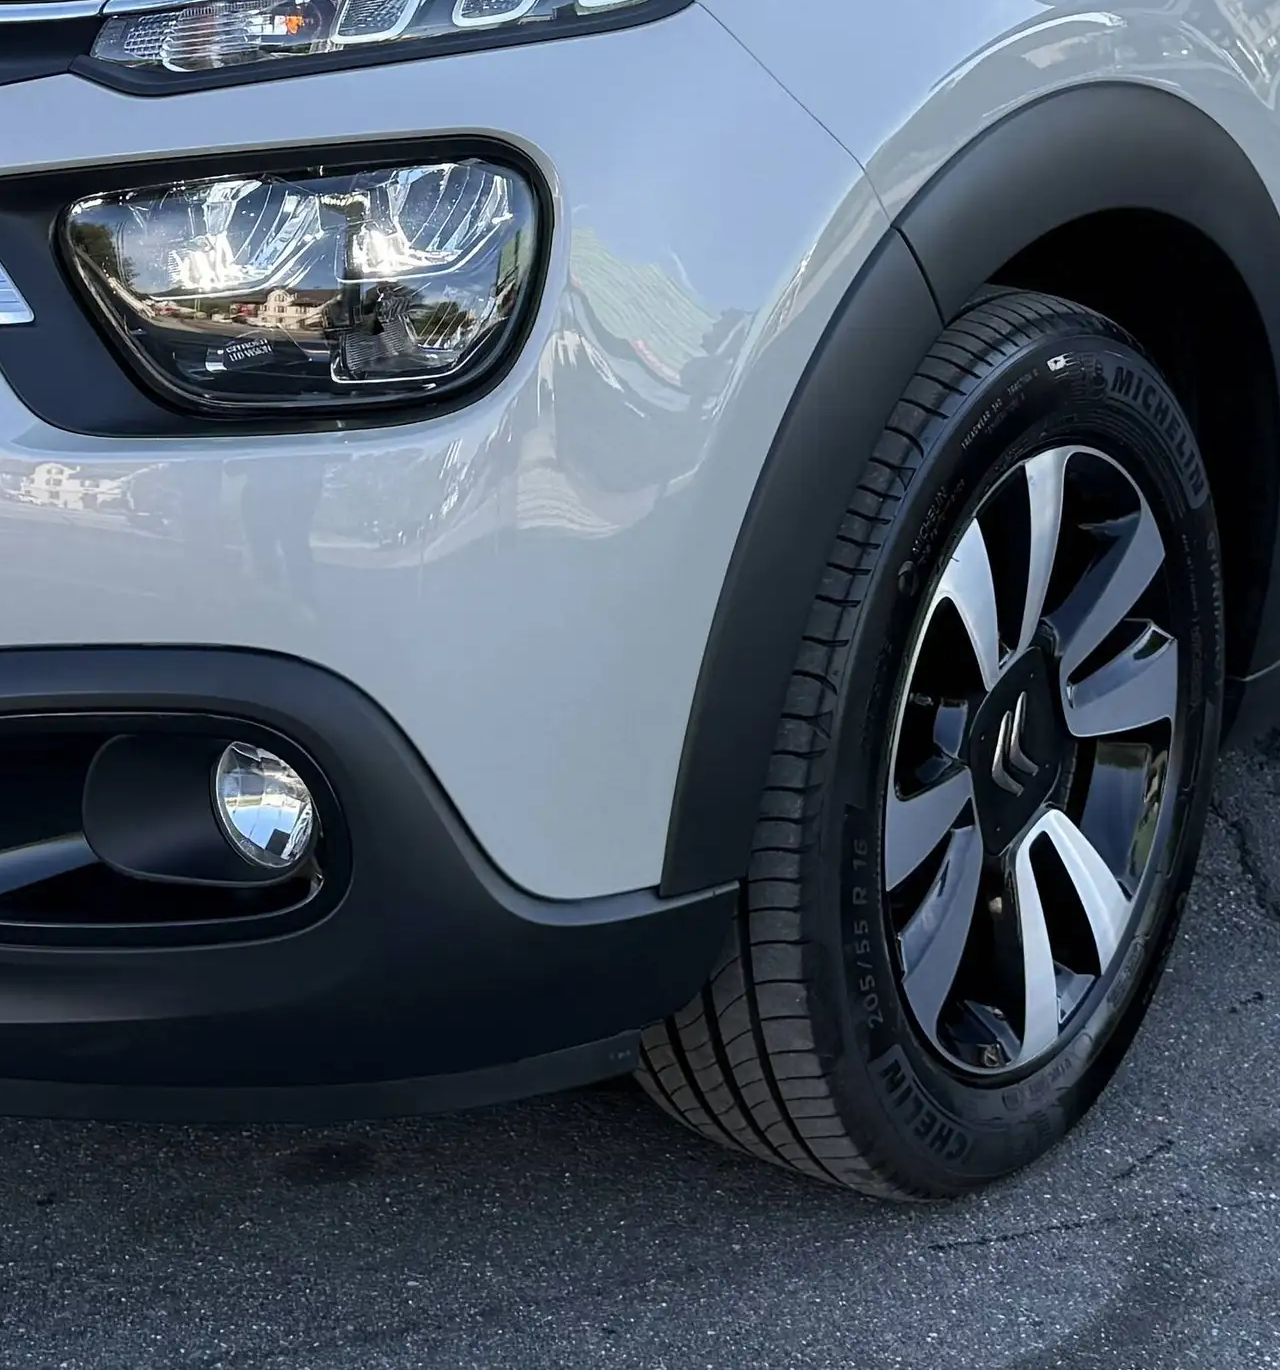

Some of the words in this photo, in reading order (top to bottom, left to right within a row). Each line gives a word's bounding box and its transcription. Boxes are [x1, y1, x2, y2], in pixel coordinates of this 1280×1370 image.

[1112, 365, 1207, 498] MICHELIN
[852, 838, 869, 872] 16
[852, 886, 868, 904] R
[852, 919, 884, 1029] 205/55
